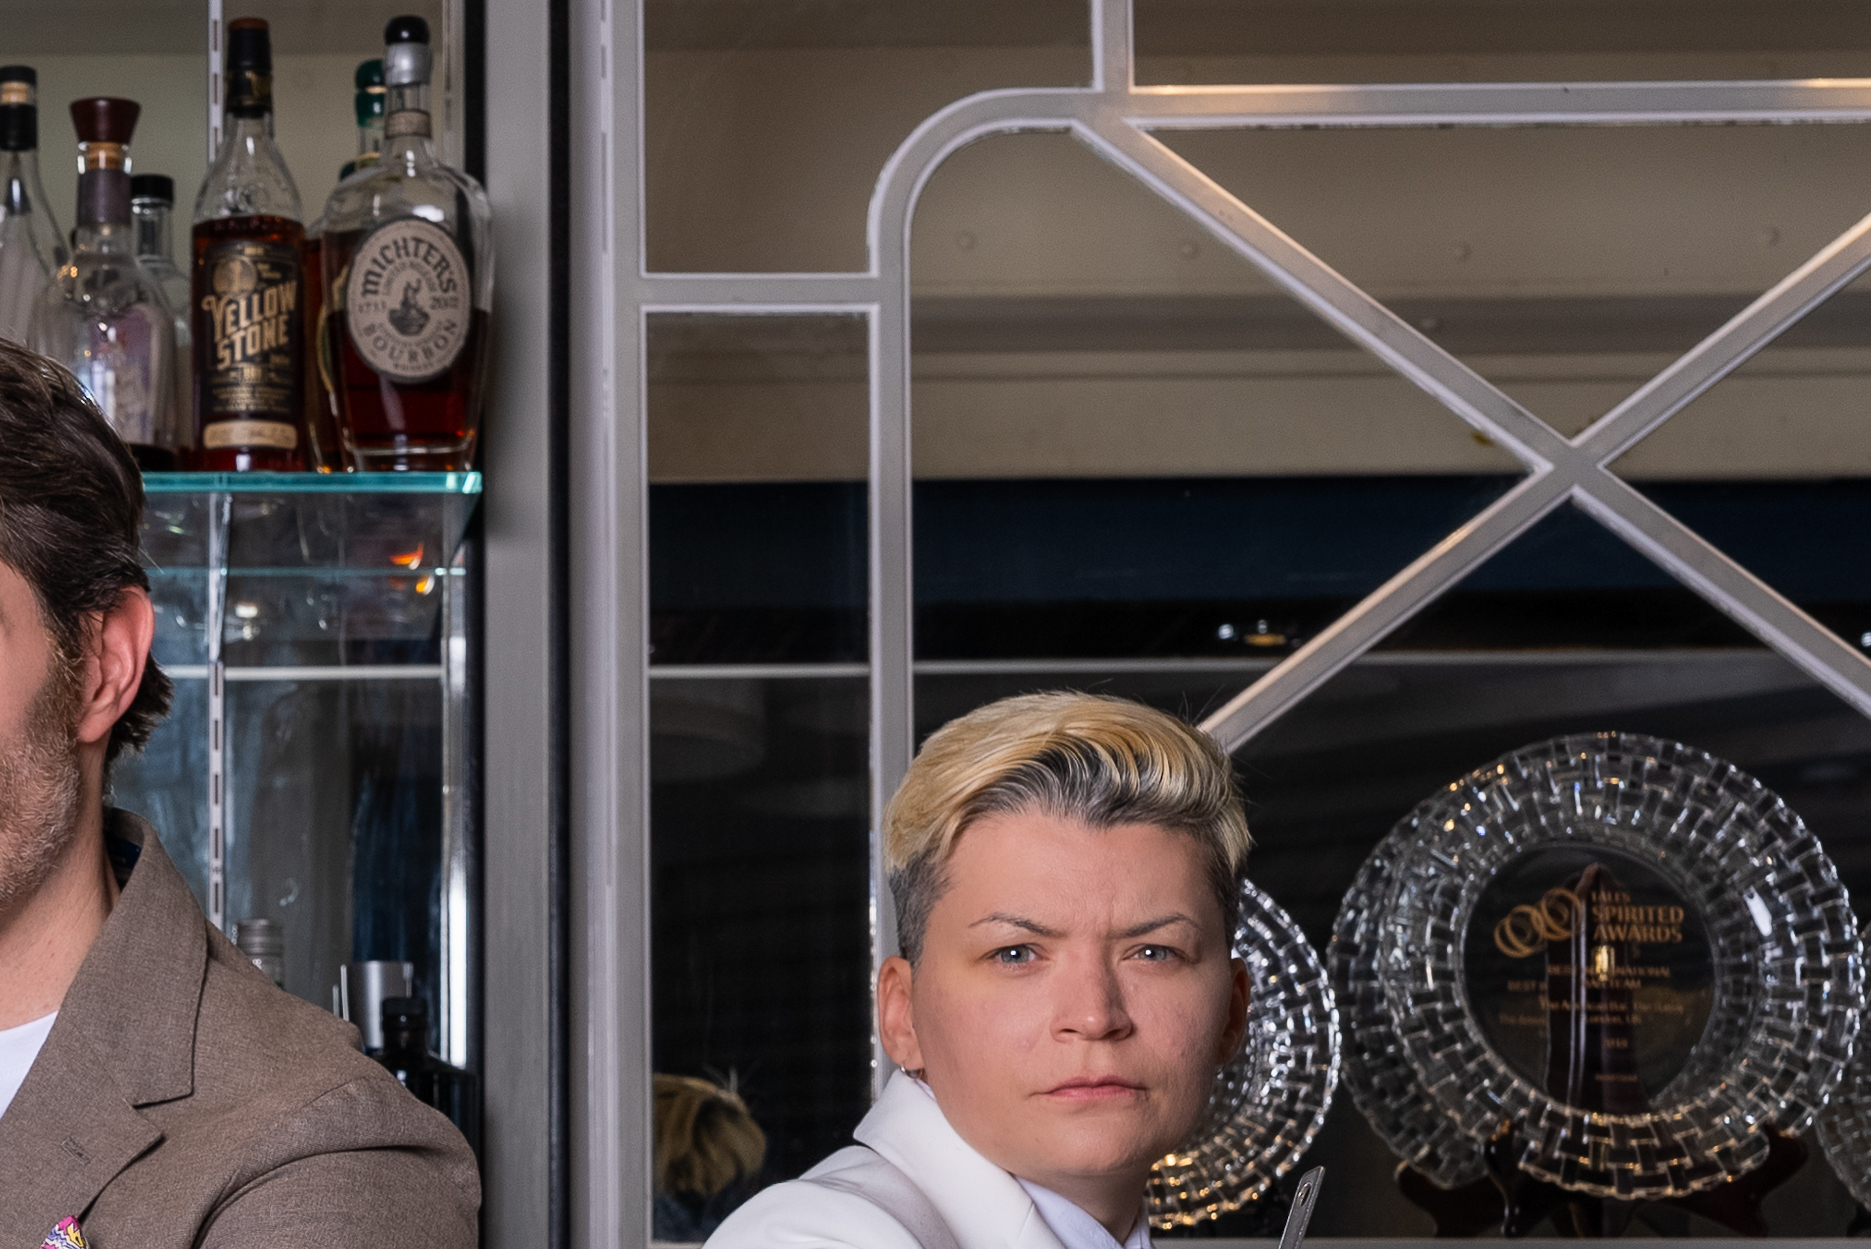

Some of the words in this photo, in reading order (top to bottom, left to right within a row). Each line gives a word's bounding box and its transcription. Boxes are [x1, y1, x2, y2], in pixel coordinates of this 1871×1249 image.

[361, 236, 458, 298] MICHTER'S
[201, 281, 297, 343] YELLOW
[217, 314, 289, 371] STONE
[1592, 906, 1684, 923] SPIRITED
[1593, 924, 1683, 943] AWARDS
